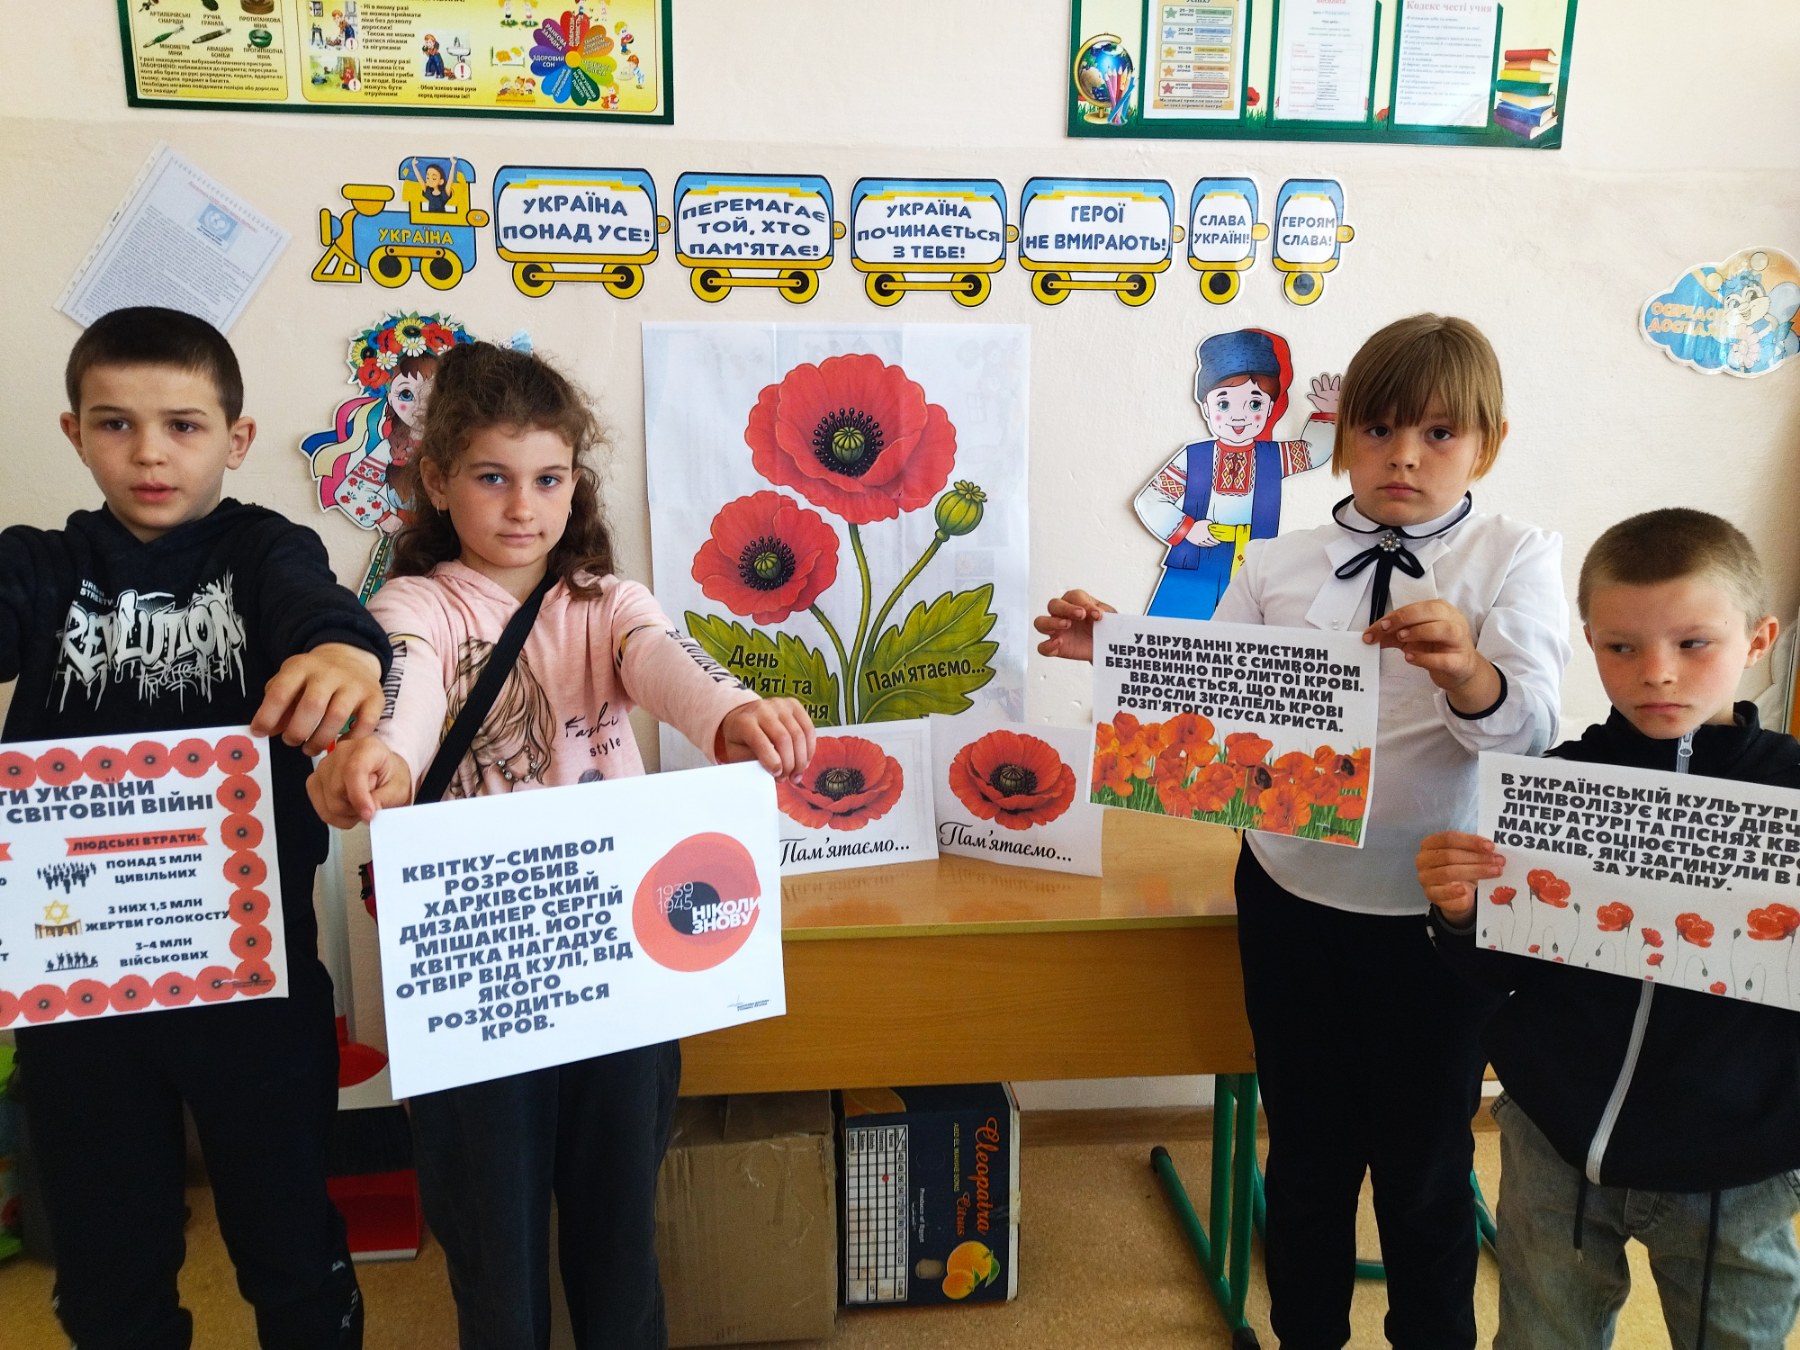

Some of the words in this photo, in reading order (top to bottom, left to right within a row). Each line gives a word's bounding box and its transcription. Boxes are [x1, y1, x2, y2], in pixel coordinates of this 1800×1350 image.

[523, 191, 628, 217] УКРАЇНА
[682, 198, 827, 223] ПЕРЕМАГАЄ
[886, 198, 972, 219] УКРАЇНА
[1070, 202, 1126, 225] ГЕРОЇ
[503, 223, 592, 243] ПОНАД
[597, 223, 650, 243] УСЕ!
[697, 217, 755, 236] ТОЙ,
[761, 220, 811, 237] ХТО
[857, 223, 1001, 243] ПОЧИНАЄТЬСЯ
[1199, 214, 1246, 227] СЛАВА
[1282, 216, 1335, 230] ГЕРОЯМ
[378, 225, 454, 246] УКРАЇНА
[1025, 235, 1050, 250] НЕ
[1054, 234, 1167, 252] ВМИРАЮТЬ!
[1194, 229, 1250, 245] УКРАЇНІ!
[1282, 234, 1333, 247] СЛАВА!
[689, 242, 819, 257] ПАМ'ЯТАЄ!
[893, 245, 906, 259] З
[911, 245, 965, 259] ТЕБЕ!
[727, 644, 779, 669] День
[1135, 634, 1143, 644] У
[1147, 635, 1231, 652] ВІРУВАННІ
[1236, 642, 1328, 661] ХРИСТИЯН
[1109, 644, 1192, 661] ЧЕРВОНИЙ
[1196, 652, 1233, 665] МАК
[1237, 656, 1247, 667] Є
[1251, 657, 1360, 677] СИМВОЛОМ
[734, 671, 787, 694] м'яті
[792, 680, 812, 695] та
[865, 658, 986, 693] Пам'ятаємо...
[1106, 656, 1208, 676] БЕЗНЕВИННО
[1212, 667, 1300, 685] ПРОЛИТОЇ
[1305, 675, 1364, 692] КРОВІ.
[1130, 672, 1242, 695] ВВАЖАЄТЬСЯ,
[1247, 683, 1275, 697] ЩО
[1280, 687, 1333, 703] МАКИ
[1121, 683, 1195, 701] ВИРОСЛИ
[1199, 692, 1285, 711] ЗКРАПЕЛЬ
[1290, 701, 1343, 718] КРОВІ
[1118, 696, 1214, 717] РОЗП'ЯТОГО
[1218, 707, 1265, 723] ІСУСА
[1270, 713, 1343, 732] ХРИСТА.
[590, 737, 622, 758] style
[35, 778, 155, 803] УКРАЇНИ
[1502, 773, 1514, 785] В
[1520, 775, 1671, 804] УКРАЇНСЬКІЙ
[1677, 794, 1798, 821] КУЛЬТУРІ
[6, 794, 135, 824] СВІТОВІЙ
[142, 791, 213, 815] ВІЙНІ
[1504, 788, 1652, 818] СИМВОЛІЗУЄ
[1657, 807, 1736, 828] КРАСУ
[1503, 802, 1631, 831] ЛІТЕРАТУРІ
[1636, 820, 1665, 836] ТА
[1671, 825, 1761, 848] ПІСНЯХ
[73, 838, 139, 852] ЛЮДСЬКІ
[142, 833, 201, 845] ВТРАТИ:
[779, 837, 911, 867] Пам'ятаємо...
[938, 821, 1073, 862] Пам'ятаємо...
[1498, 816, 1562, 836] МАКУ
[1566, 826, 1737, 861] АСОЦІЮЄТЬСЯ
[1743, 850, 1756, 863] З
[1762, 852, 1800, 869] КР
[106, 856, 157, 869] ПОНАД
[159, 856, 167, 865] 5
[169, 853, 202, 864] МЛН
[402, 837, 614, 883] КВІТКУ-СИМВОЛ
[1493, 829, 1593, 858] КОЗАКІВ,
[1598, 847, 1635, 863] ЯКІ
[1641, 853, 1769, 881] ЗАГИНУЛИ
[1775, 870, 1790, 884] В
[114, 868, 197, 885] ЦИВІЛЬНИХ
[444, 861, 580, 895] РОЗРОБИВ
[1592, 860, 1620, 875] ЗА
[1625, 865, 1732, 891] УКРАЇНУ.
[424, 870, 600, 918] ХАРКІВСЬКИЙ
[656, 881, 694, 902] 1939
[118, 903, 148, 914] НИХ
[150, 900, 168, 912] 1,5
[170, 898, 203, 909] МЛН
[400, 905, 536, 945] ДИЗАЙНЕР
[542, 884, 622, 917] СЕРГІЙ
[657, 894, 693, 915] 1945
[692, 896, 761, 920] НІКОЛИ
[85, 918, 144, 932] ЖЕРТВИ
[147, 910, 230, 926] ГОЛОКОСТУ
[415, 923, 540, 958] МІШАКІН.
[546, 909, 611, 934] ЙОГО
[692, 911, 753, 935] ЗНОВУ
[160, 937, 193, 948] МЛН
[411, 948, 502, 978] КВІТКА
[508, 927, 617, 959] НАГАДУЄ
[119, 950, 209, 967] ВІЙСЬКОВИХ
[396, 972, 472, 998] ОТВІР
[479, 963, 521, 984] ВІД
[526, 951, 588, 975] КУЛІ,
[594, 942, 633, 962] ВІД
[479, 975, 561, 1004] ЯКОГО
[428, 983, 609, 1032] РОЗХОДИТЬСЯ
[482, 1015, 554, 1041] КРОВ.
[967, 1116, 1000, 1236] Cleopatra
[956, 1191, 971, 1237] Citrus
